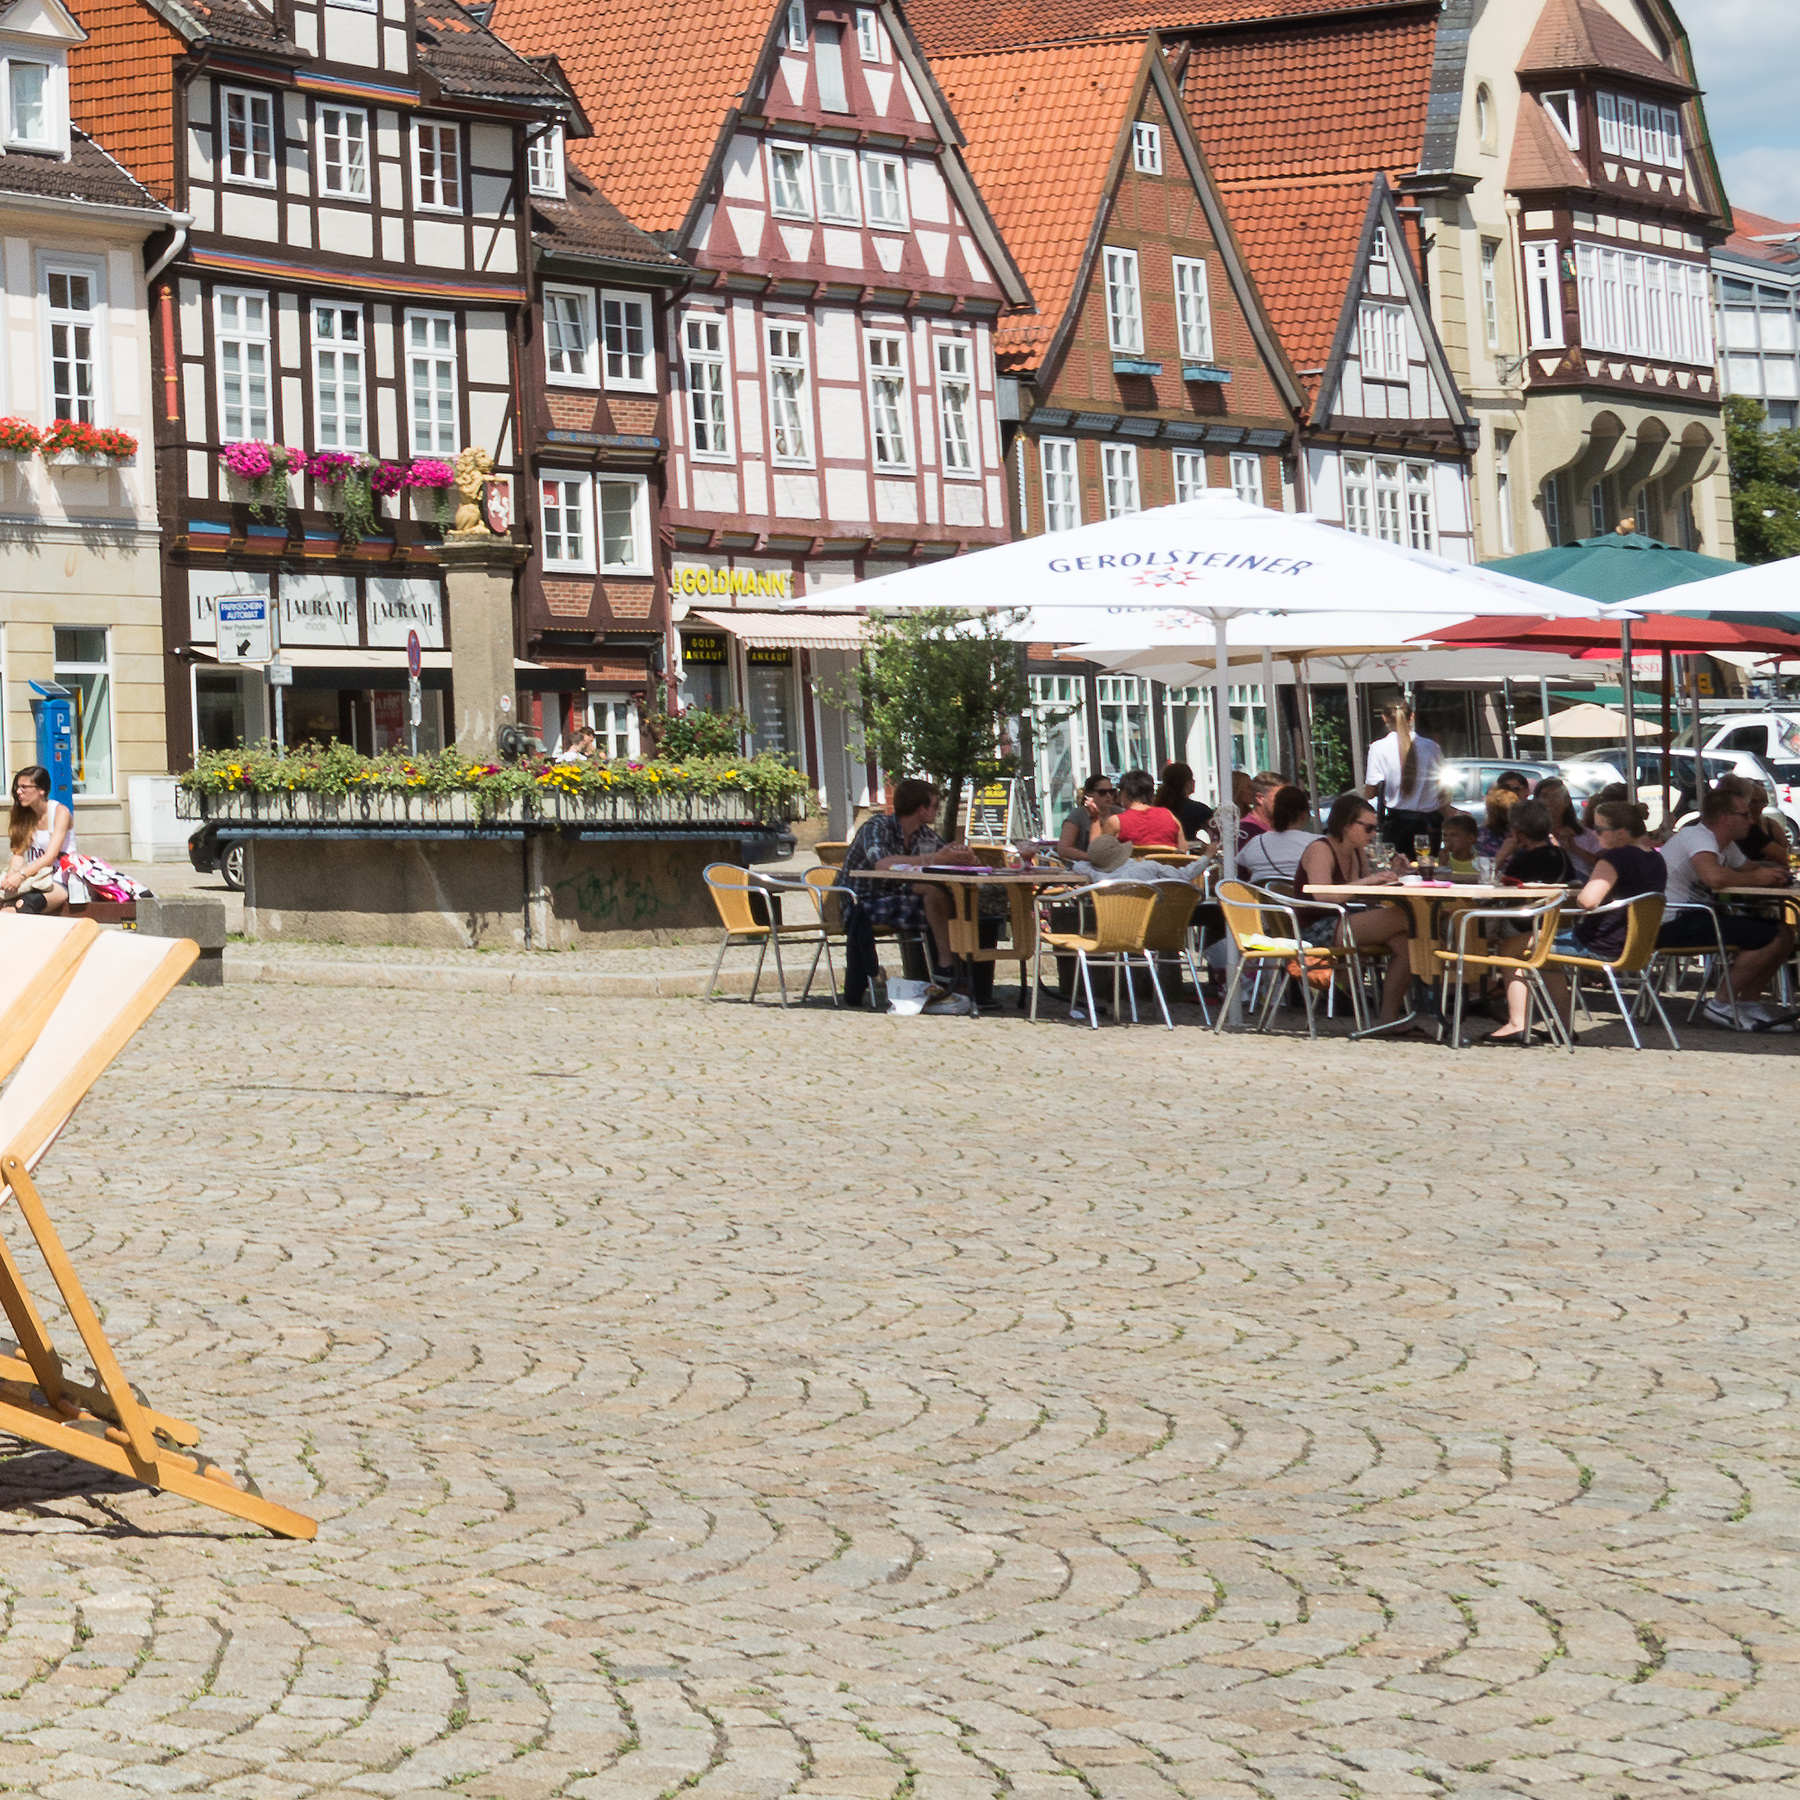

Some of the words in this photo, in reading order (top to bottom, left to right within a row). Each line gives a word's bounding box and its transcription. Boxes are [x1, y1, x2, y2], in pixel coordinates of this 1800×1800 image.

[1048, 549, 1313, 576] GEROLSTEINER
[682, 567, 785, 598] GOLDMANN
[227, 610, 260, 620] AUTOMAT
[286, 598, 333, 623] LAURA
[373, 602, 418, 626] LAURA
[691, 638, 716, 648] GOLD
[751, 652, 787, 661] ANKAUF
[56, 712, 65, 728] P
